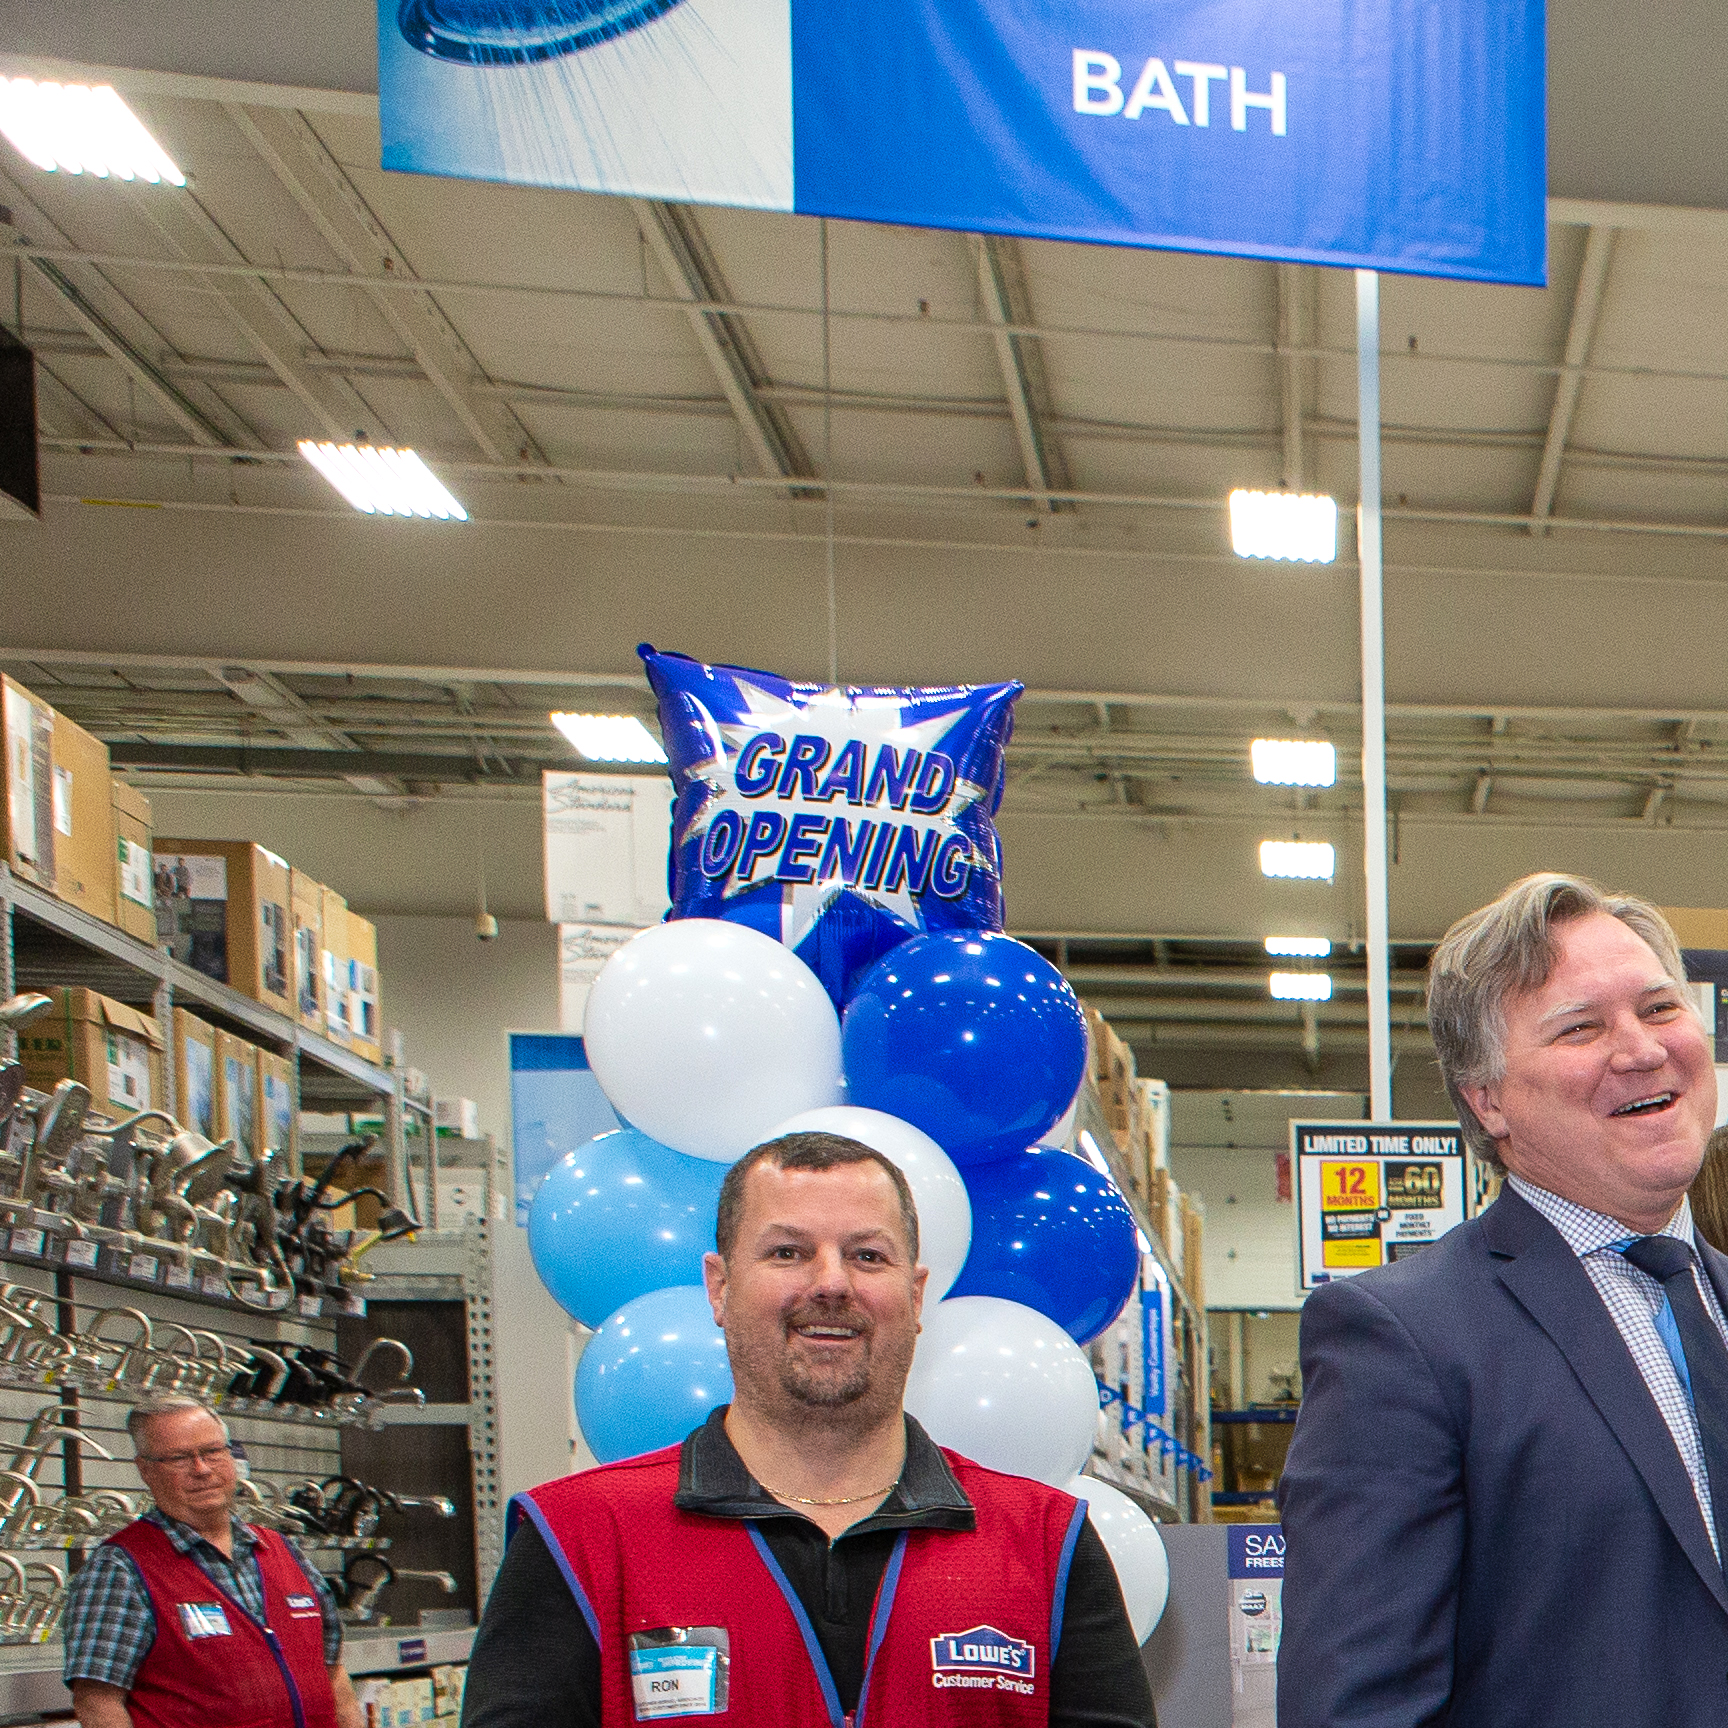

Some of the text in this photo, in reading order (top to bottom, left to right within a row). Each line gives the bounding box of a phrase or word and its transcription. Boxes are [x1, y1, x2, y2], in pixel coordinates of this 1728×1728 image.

[1072, 49, 1287, 136] BATH
[734, 732, 957, 815] GRAND
[702, 808, 973, 899] OPENING
[1304, 1135, 1458, 1154] LIMITED TIME ONLY!
[1335, 1167, 1367, 1195] 12
[1405, 1166, 1441, 1195] 60
[1326, 1196, 1375, 1207] MONTHS
[1388, 1195, 1440, 1208] MONTHS
[949, 1639, 1022, 1667] LOWE'S
[651, 1679, 680, 1693] RON
[933, 1673, 1035, 1695] Customer Service
